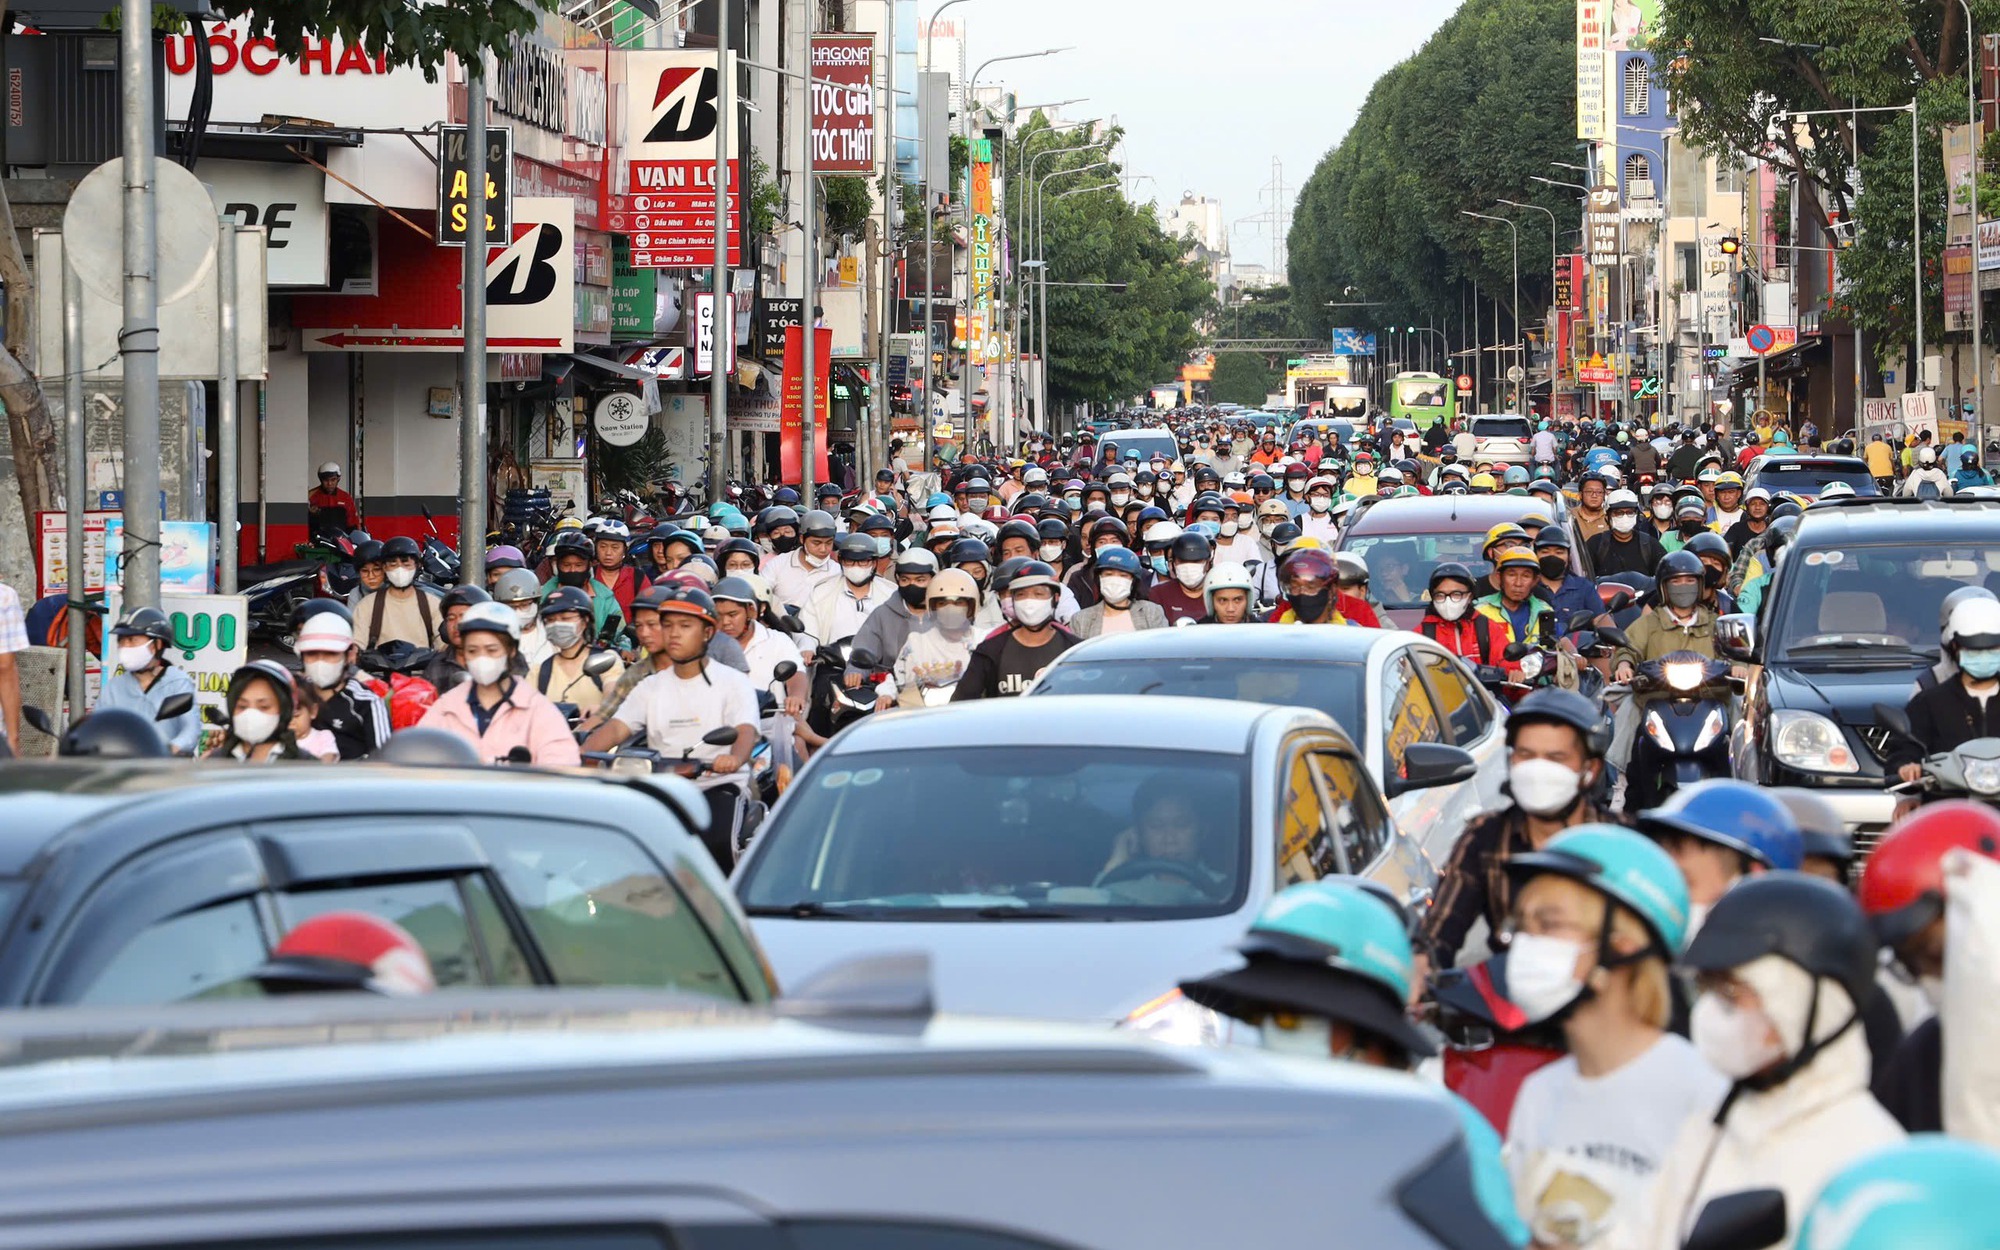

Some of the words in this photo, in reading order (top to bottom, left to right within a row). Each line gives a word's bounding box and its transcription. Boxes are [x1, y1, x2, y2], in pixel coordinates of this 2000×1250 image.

[812, 46, 870, 60] HAGONA
[812, 120, 838, 161] TÓC
[840, 120, 873, 165] THẬT
[637, 167, 685, 191] VẠN
[1704, 260, 1726, 274] LED
[768, 300, 799, 312] HỚT
[600, 424, 618, 432] Snow
[620, 423, 644, 431] Station
